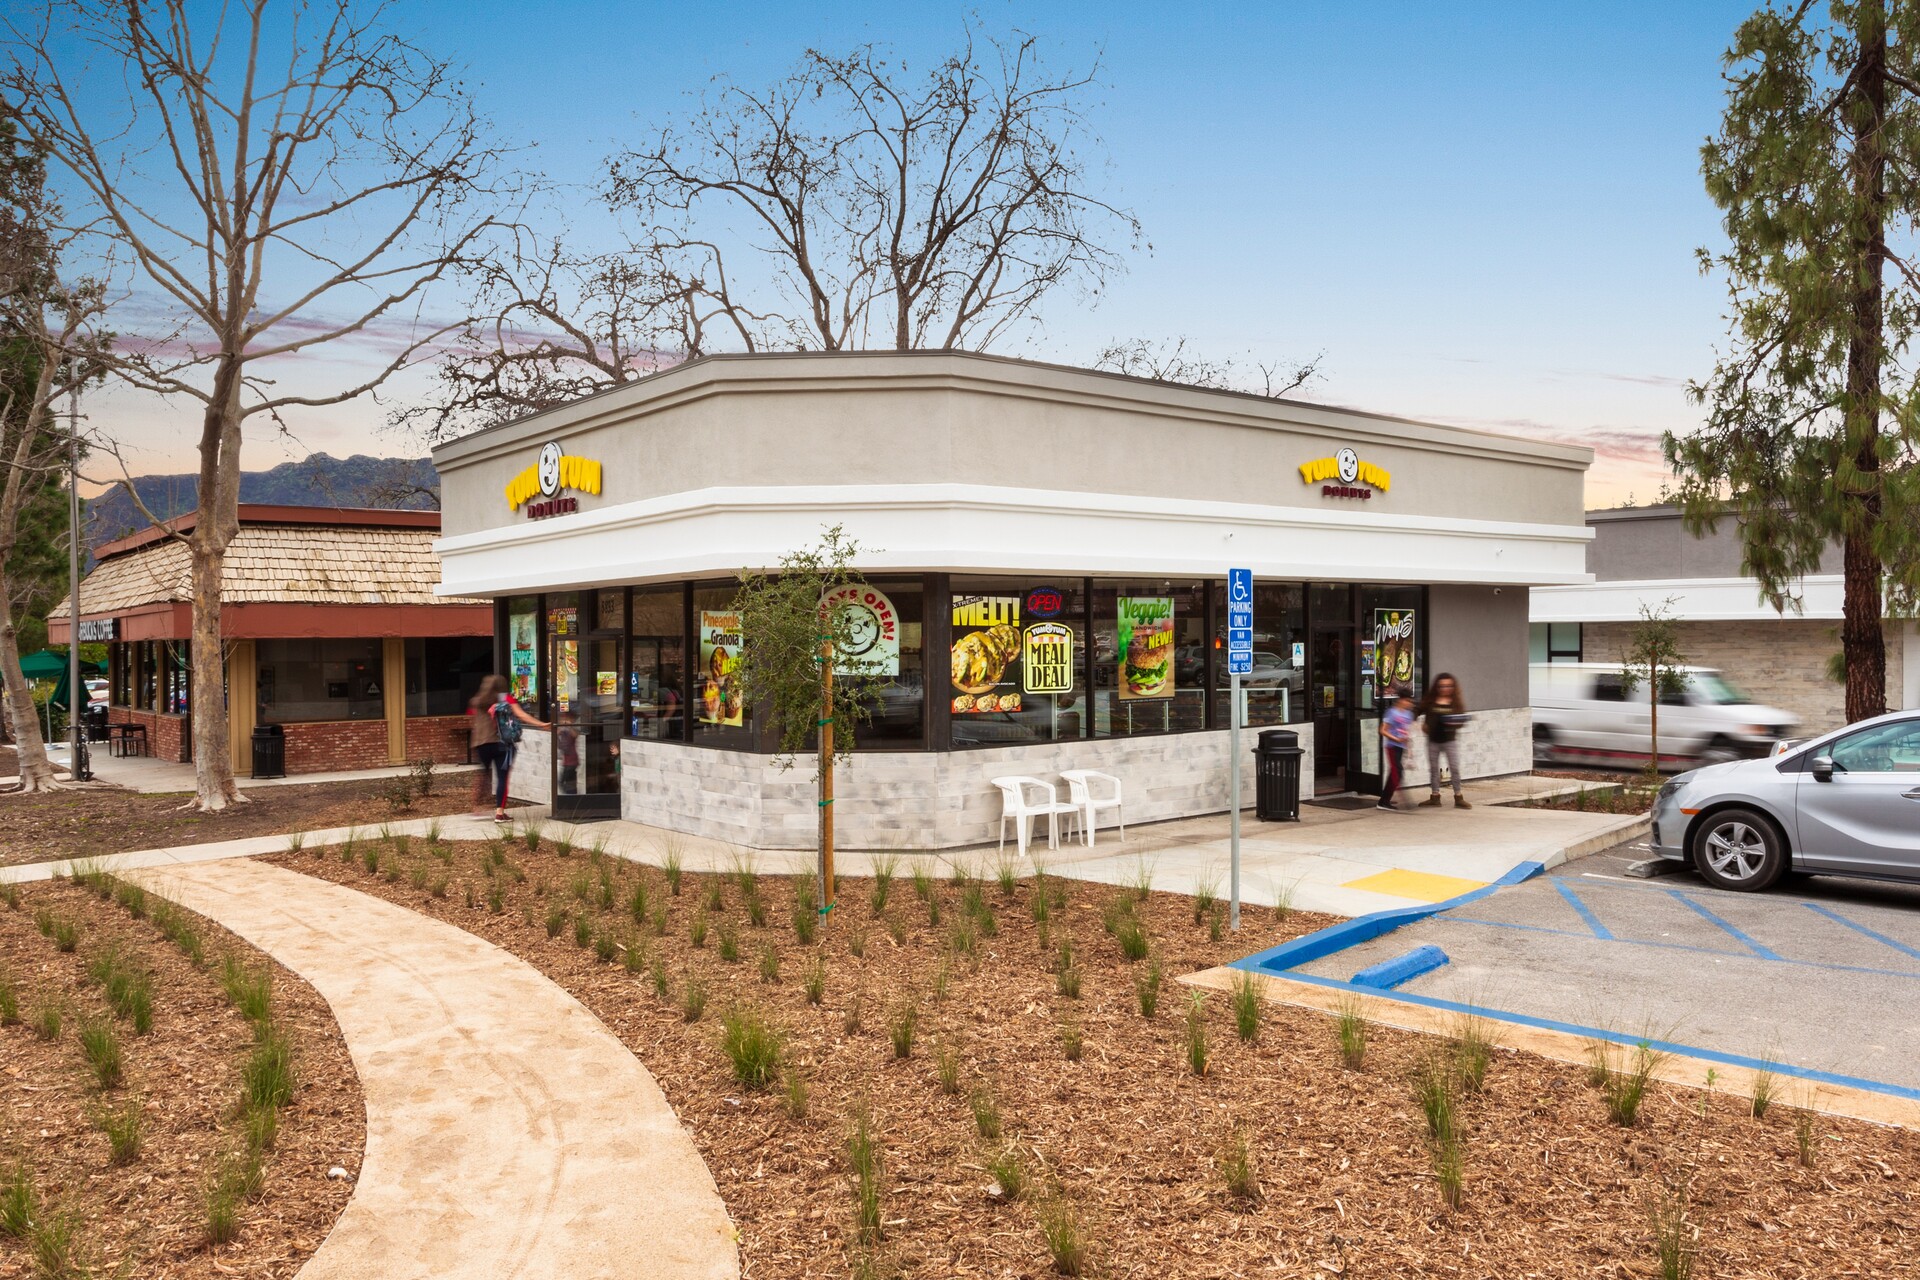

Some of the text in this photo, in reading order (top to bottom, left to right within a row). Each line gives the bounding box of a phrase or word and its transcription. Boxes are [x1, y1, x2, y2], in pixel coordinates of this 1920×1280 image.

[505, 455, 602, 512] YUM YUM
[1299, 457, 1391, 493] YUM YUM
[1322, 485, 1372, 500] DONUTS
[527, 497, 577, 519] DONUTS
[952, 595, 1020, 627] MELT!
[1027, 594, 1063, 611] OPEN
[1119, 597, 1173, 626] Veggie!
[1230, 601, 1251, 613] PARKING
[703, 611, 739, 635] Pineapple
[864, 592, 896, 642] OPEN!
[1233, 614, 1247, 627] ONLY
[97, 618, 114, 640] COFFEE
[711, 629, 739, 645] Granola
[1032, 626, 1066, 635] YUM YUM
[1237, 631, 1245, 639] VAN
[1148, 630, 1173, 650] NEW!
[1231, 641, 1251, 649] ACCESSIBLE
[1031, 643, 1067, 665] MEAL
[1233, 653, 1249, 661] MINIMUM
[1295, 644, 1302, 655] A
[1230, 662, 1251, 672] FINE $250
[1031, 665, 1068, 688] DEAL
